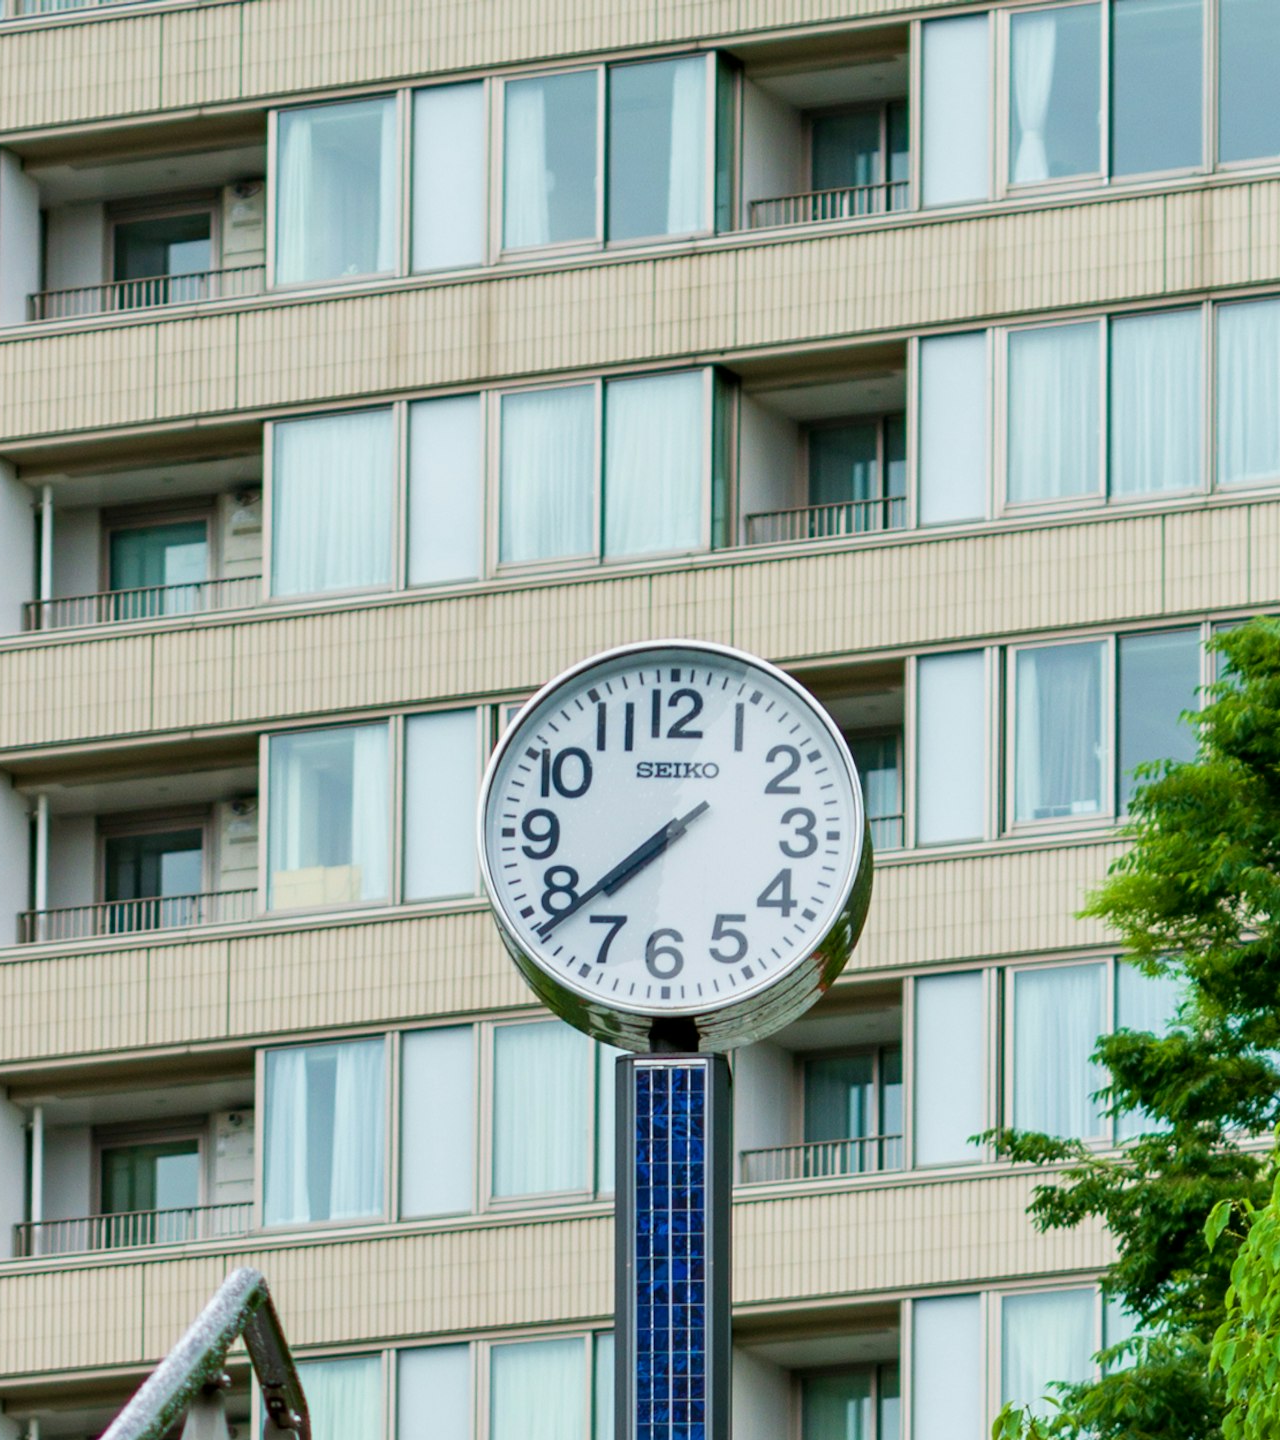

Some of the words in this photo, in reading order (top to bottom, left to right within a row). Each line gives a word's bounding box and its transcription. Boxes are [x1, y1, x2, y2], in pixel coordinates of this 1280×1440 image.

[596, 702, 634, 752] 11
[651, 689, 704, 739] 12
[734, 702, 745, 752] 1
[540, 747, 593, 799] 10
[636, 761, 720, 779] SEIKO
[764, 744, 801, 795] 2
[521, 808, 560, 860] 9
[779, 807, 819, 859] 3
[541, 865, 579, 916] 8
[756, 868, 798, 918] 4
[589, 915, 628, 964] 7
[645, 928, 685, 980] 6
[709, 914, 748, 964] 5
